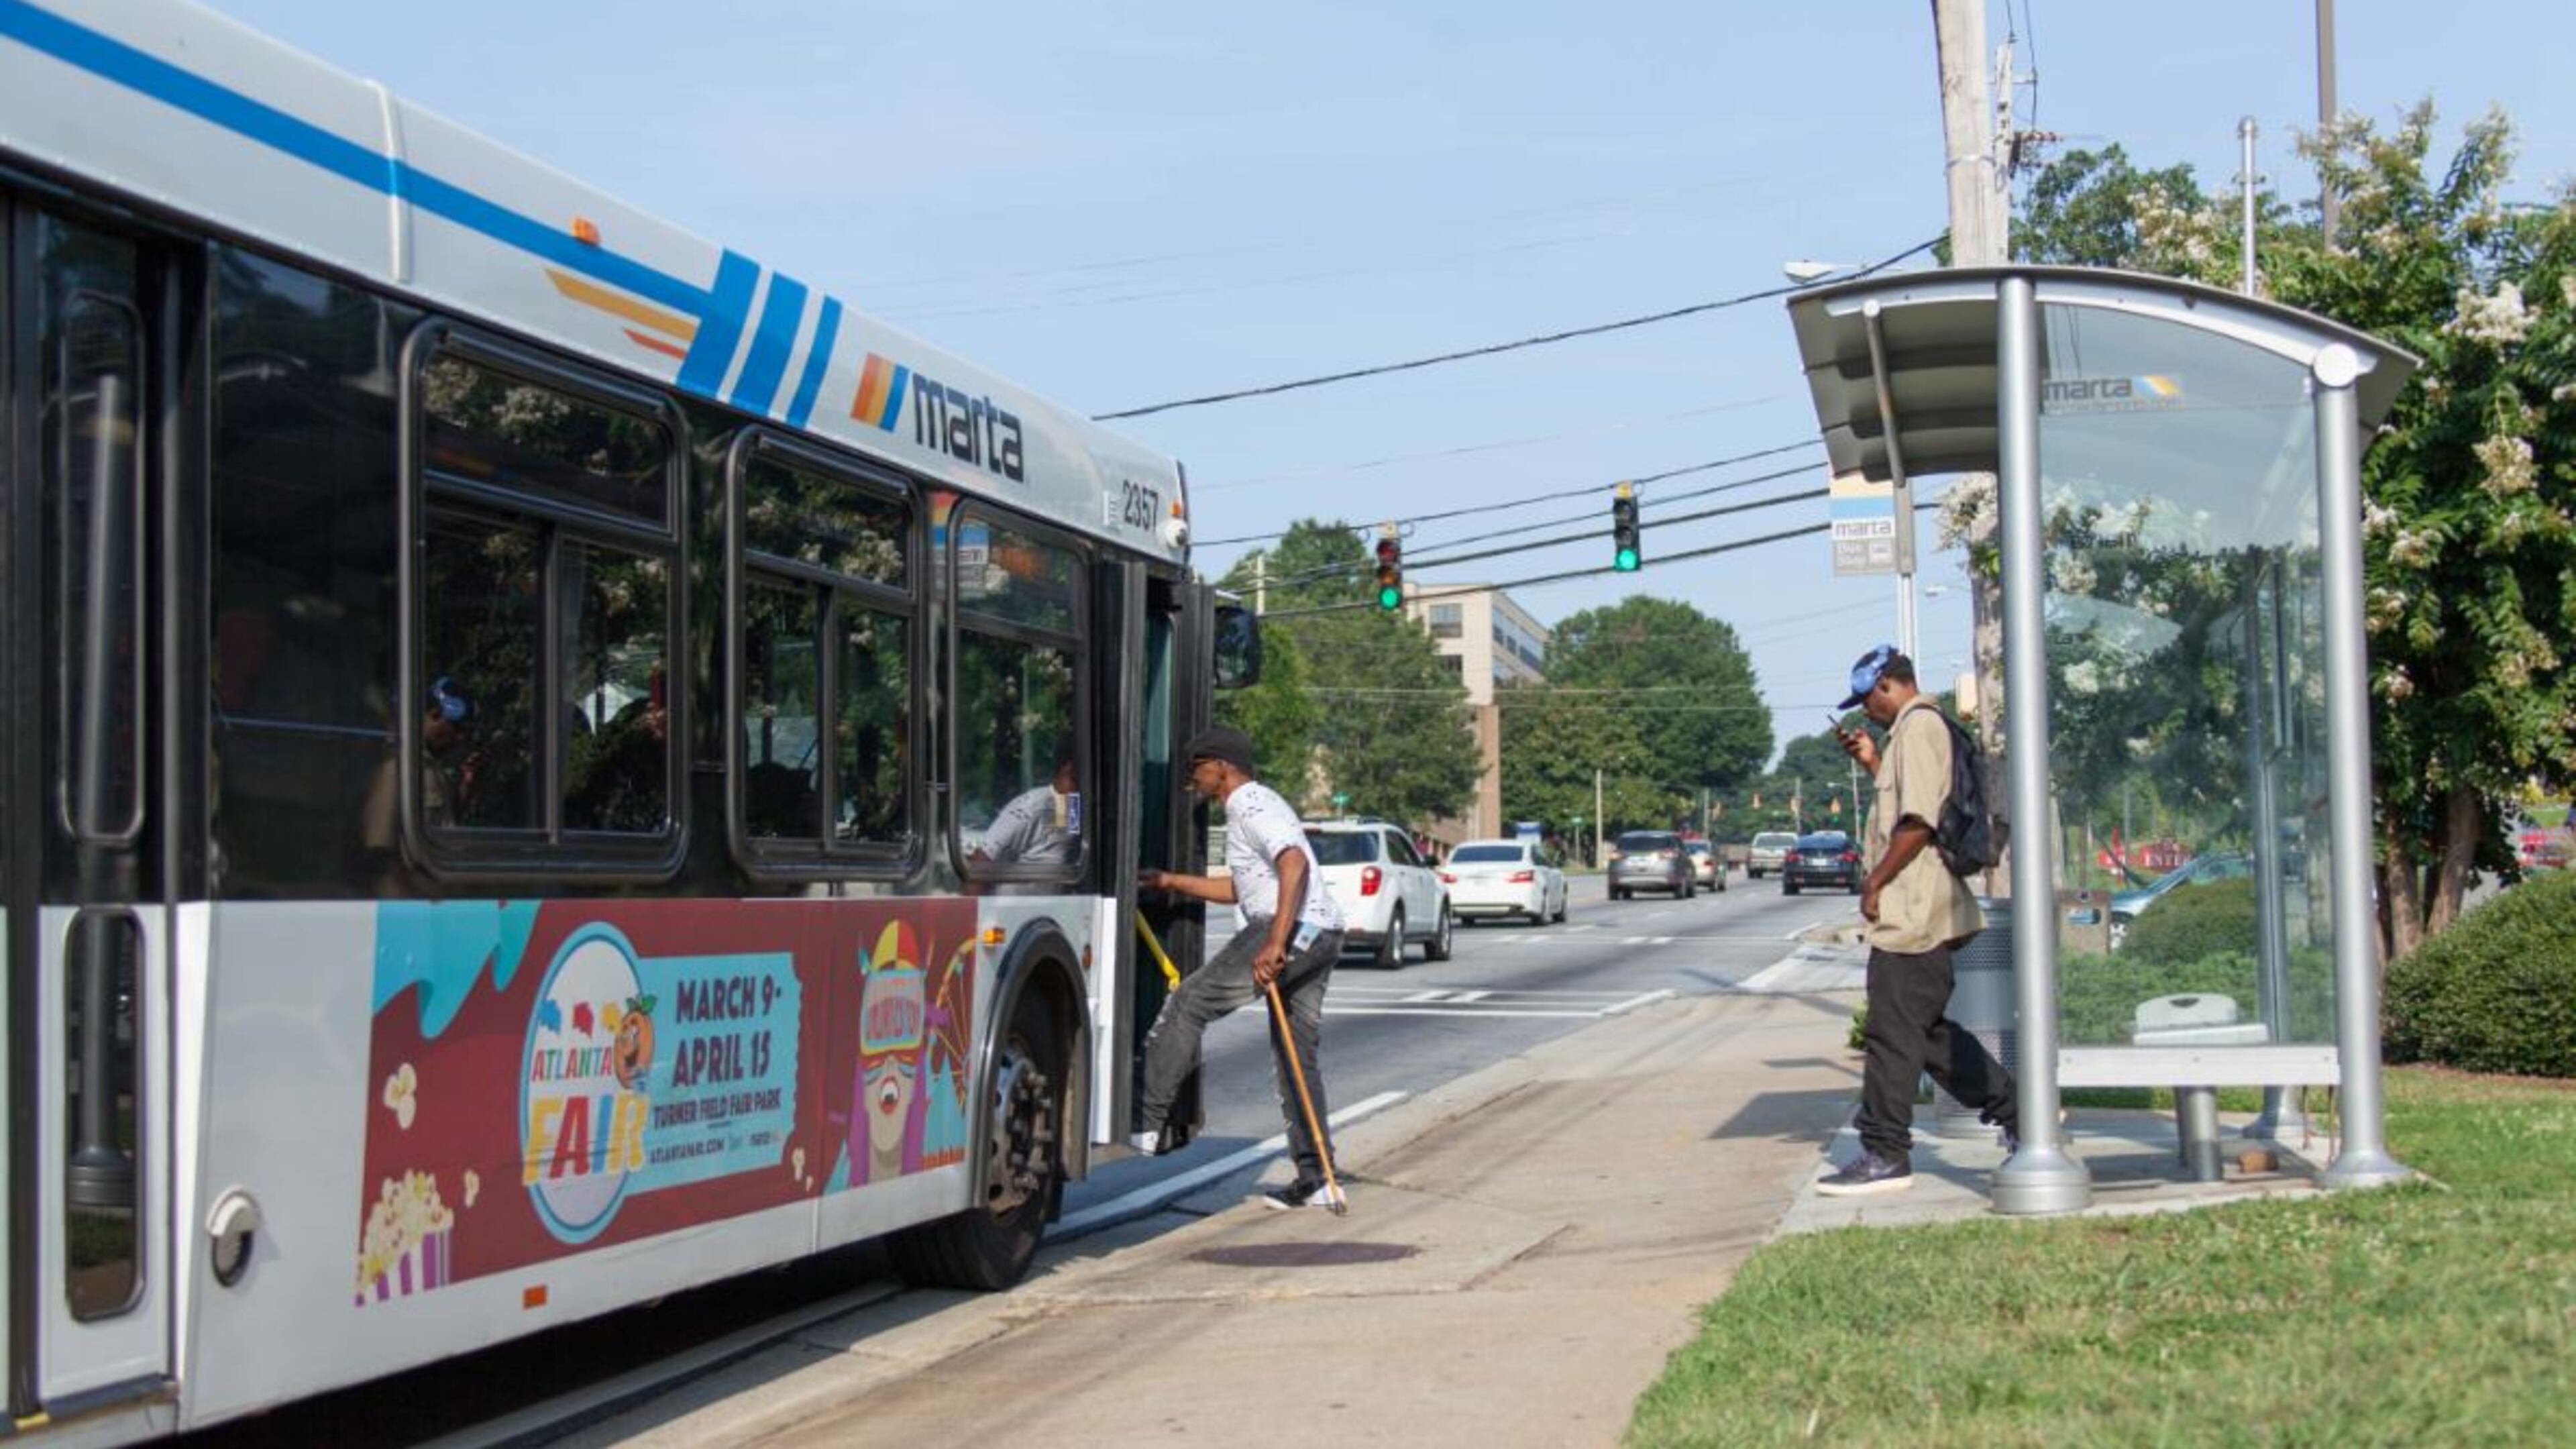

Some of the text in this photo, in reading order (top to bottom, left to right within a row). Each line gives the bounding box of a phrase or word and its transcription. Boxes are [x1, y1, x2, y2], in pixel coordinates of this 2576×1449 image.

[2045, 378, 2131, 400] marta
[912, 373, 1024, 483] marta
[1122, 479, 1159, 532] 2357
[1836, 521, 1891, 537] marta
[676, 976, 756, 1024] MARCH
[531, 1046, 613, 1081] ATLANTA
[672, 1030, 771, 1087] APRIL 15
[755, 1087, 782, 1112] PARK
[523, 1094, 647, 1186] FAIR
